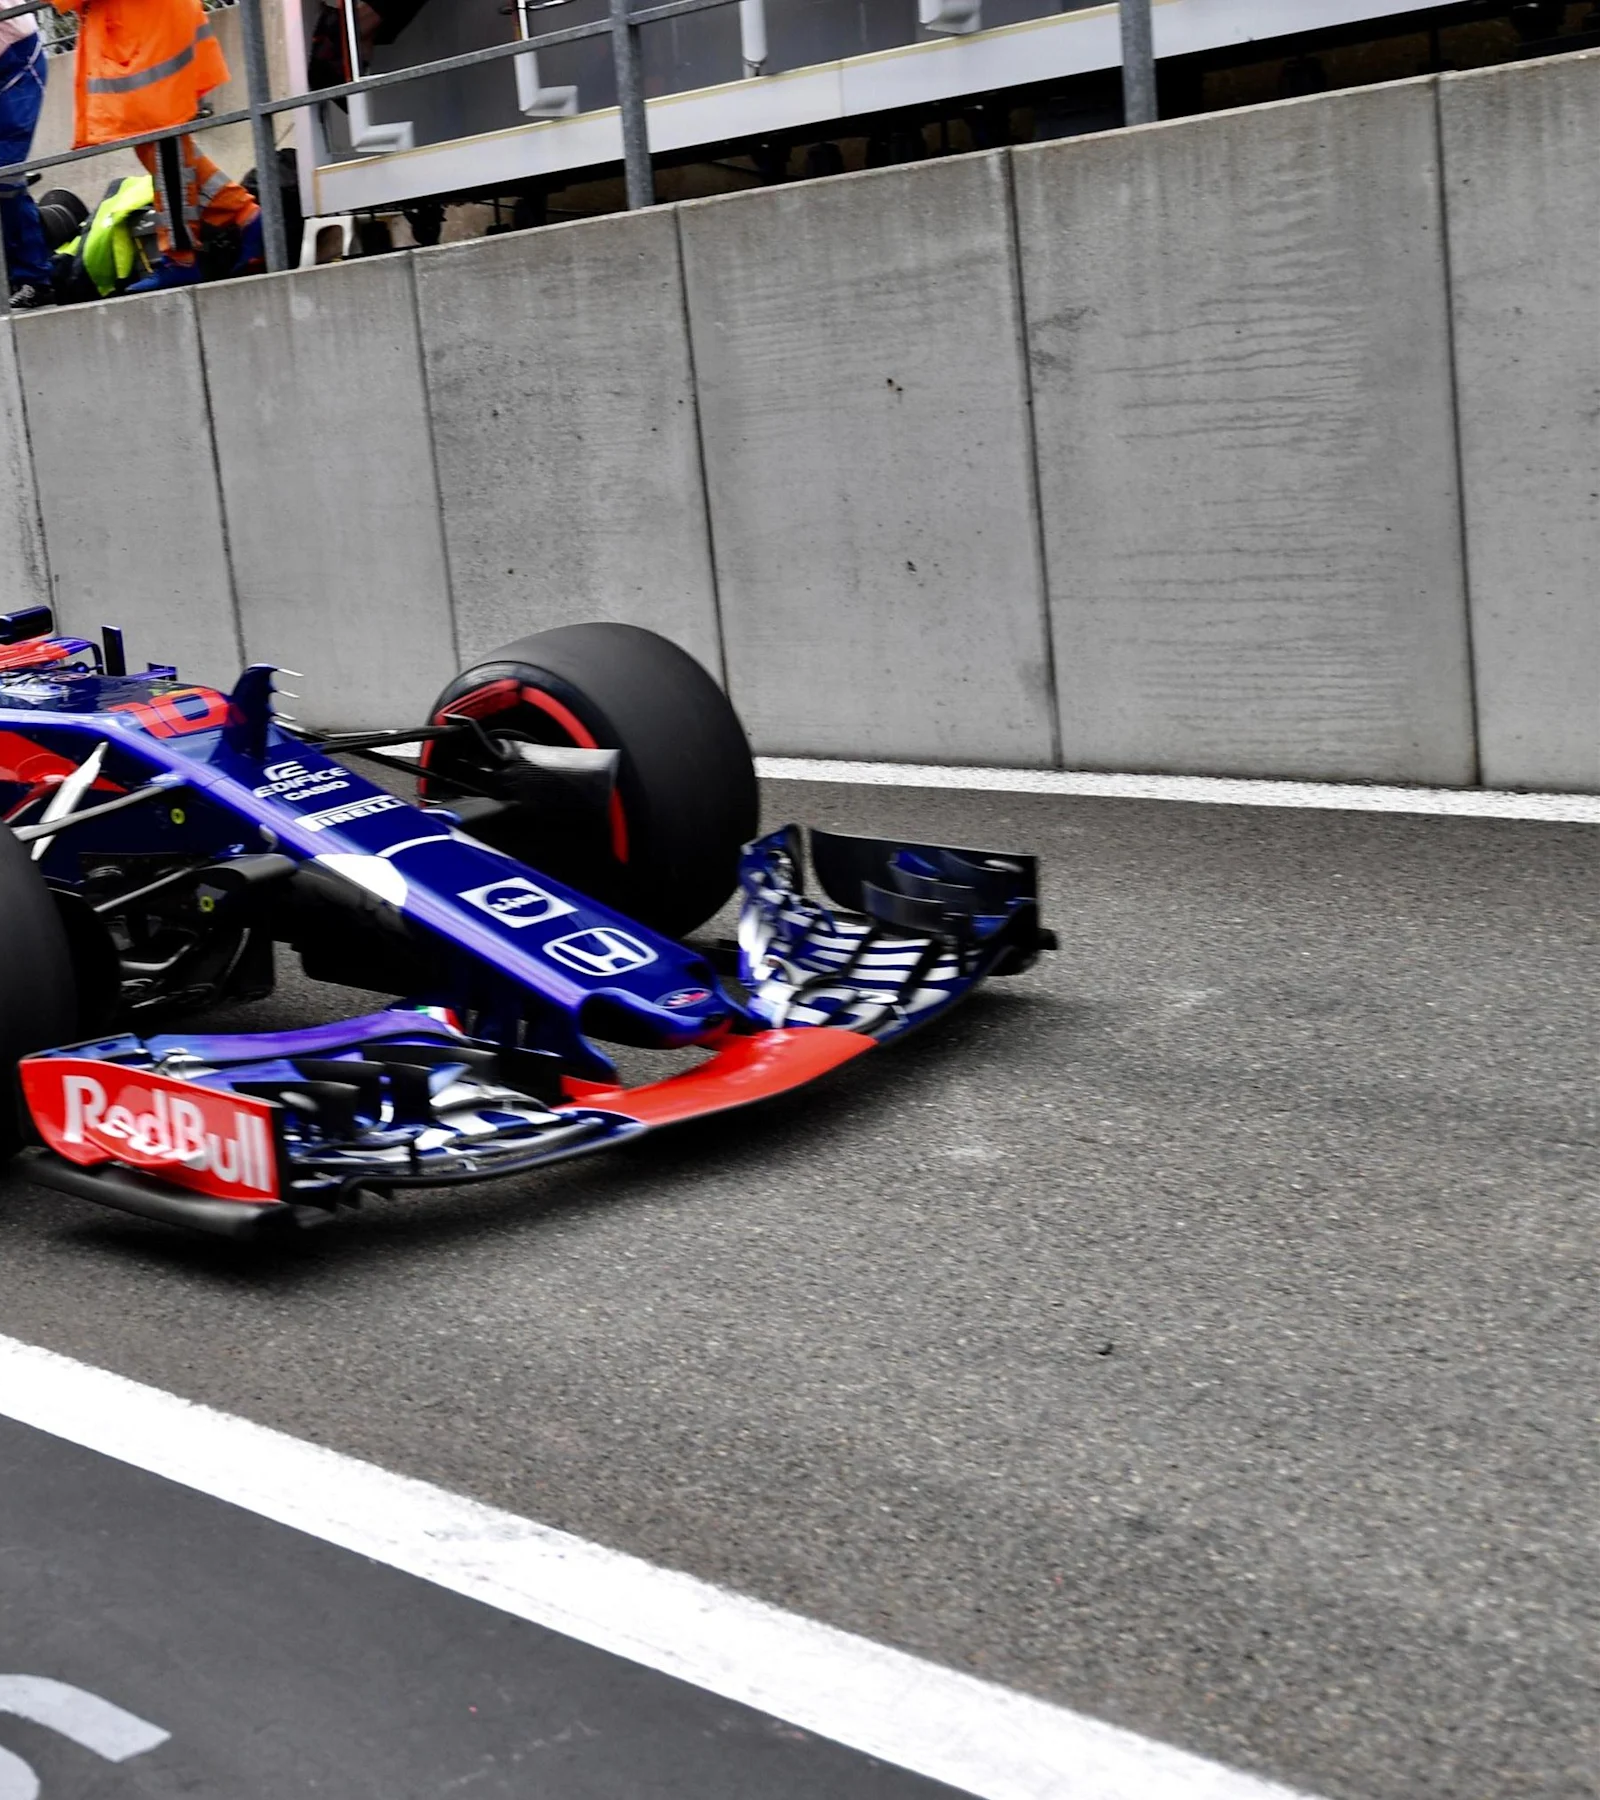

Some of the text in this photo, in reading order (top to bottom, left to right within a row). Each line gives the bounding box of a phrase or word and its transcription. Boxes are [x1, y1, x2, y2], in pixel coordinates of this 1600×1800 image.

[108, 686, 229, 740] 10
[252, 766, 350, 798] EDIFICE
[283, 781, 350, 801] CASIO
[293, 794, 408, 832] PIRELLI
